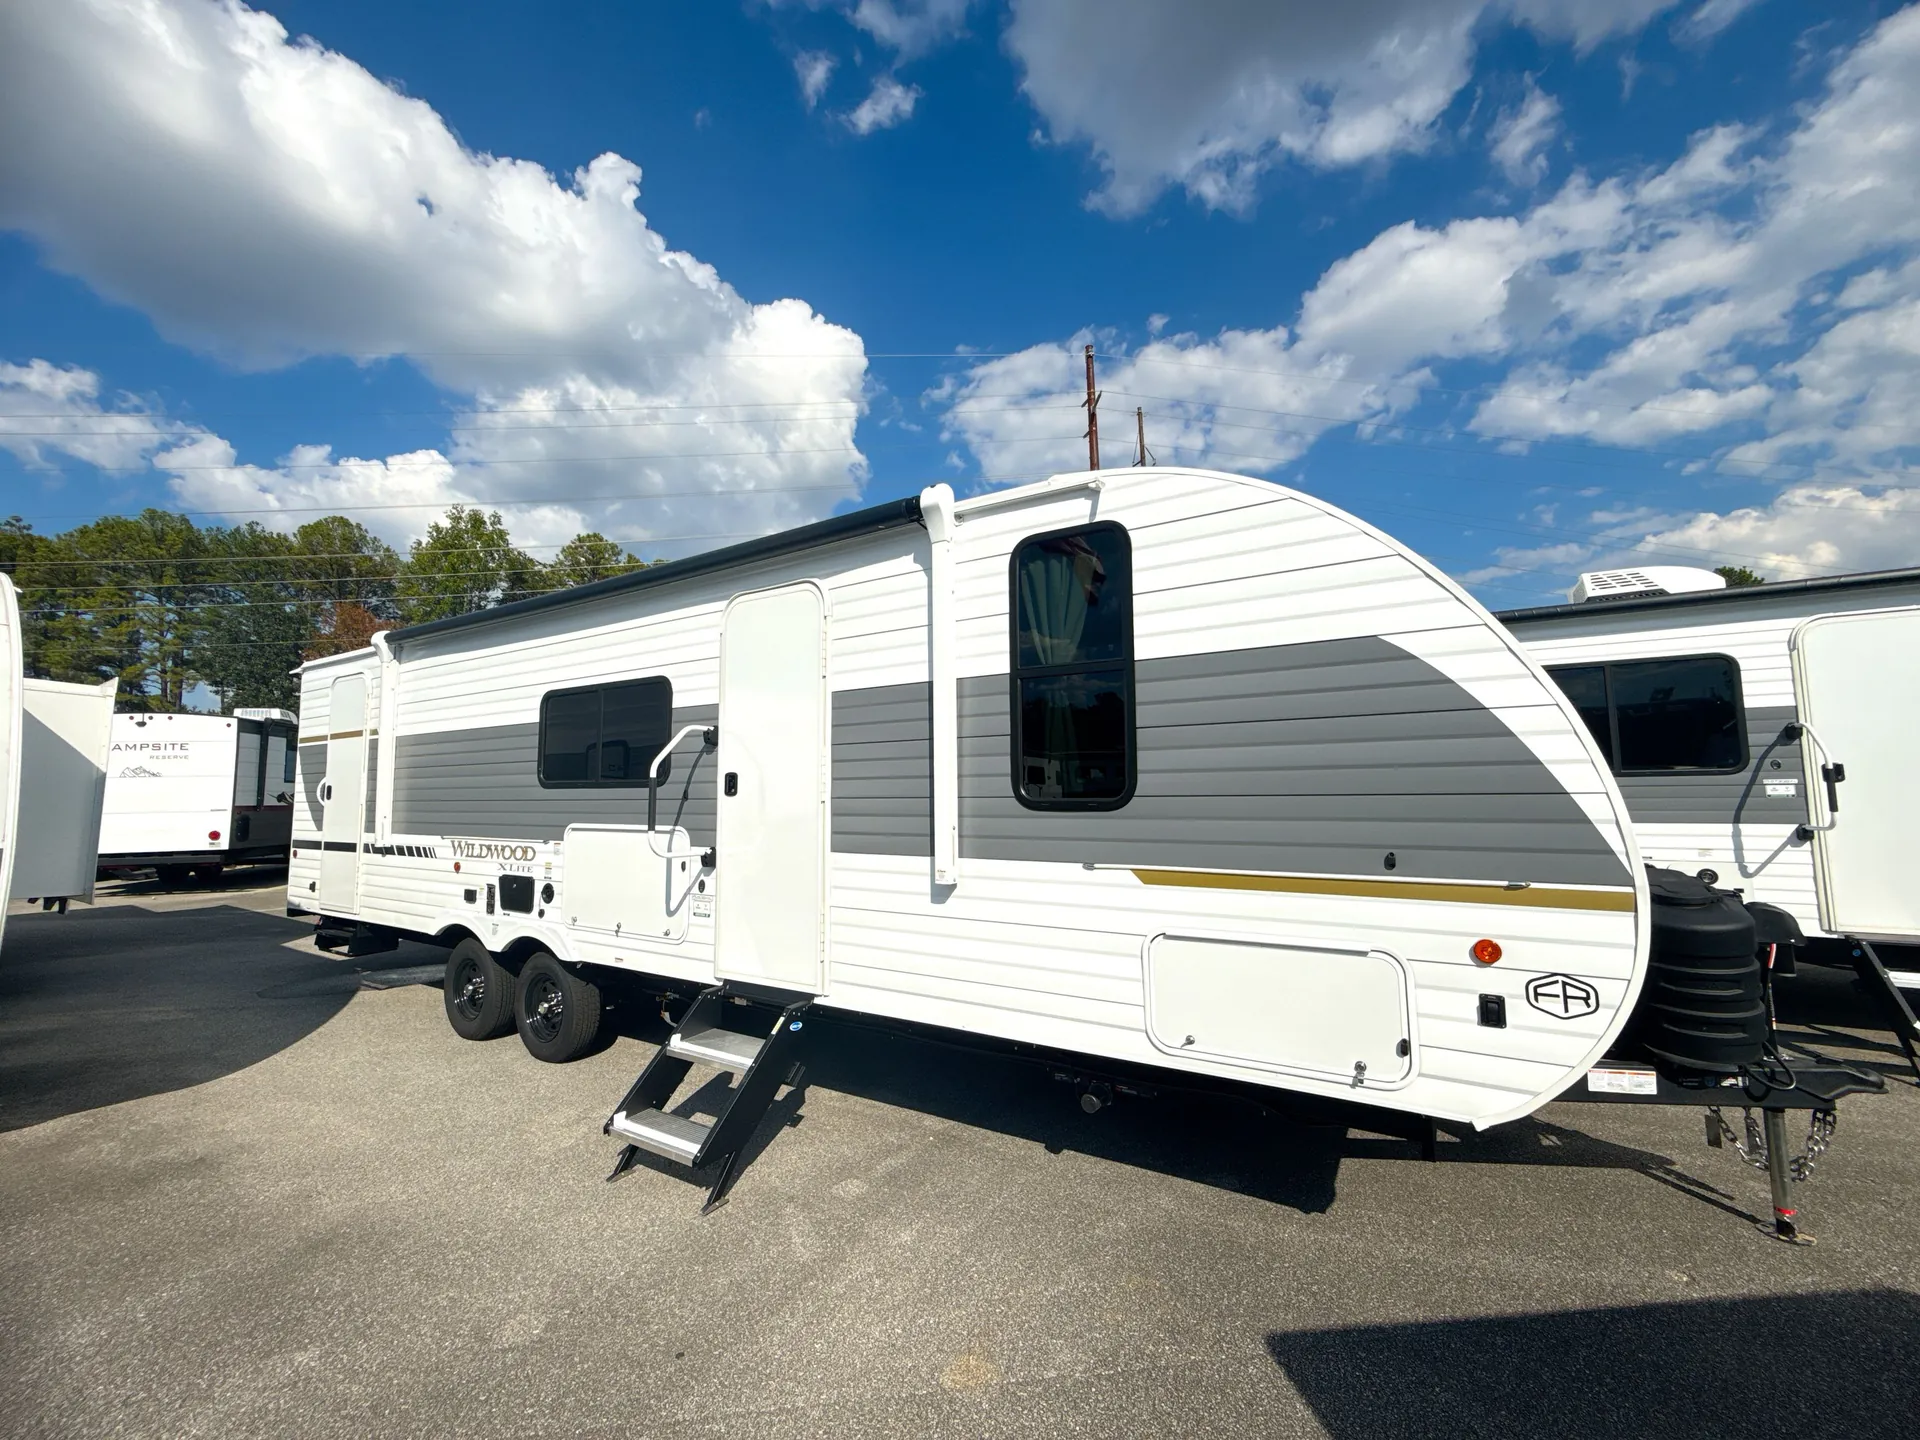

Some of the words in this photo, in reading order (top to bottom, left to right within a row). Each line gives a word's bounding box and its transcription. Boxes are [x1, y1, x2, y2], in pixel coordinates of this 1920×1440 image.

[111, 742, 189, 752] AMPSITE
[450, 840, 536, 861] WILDWOOD
[1533, 979, 1592, 1013] FR
